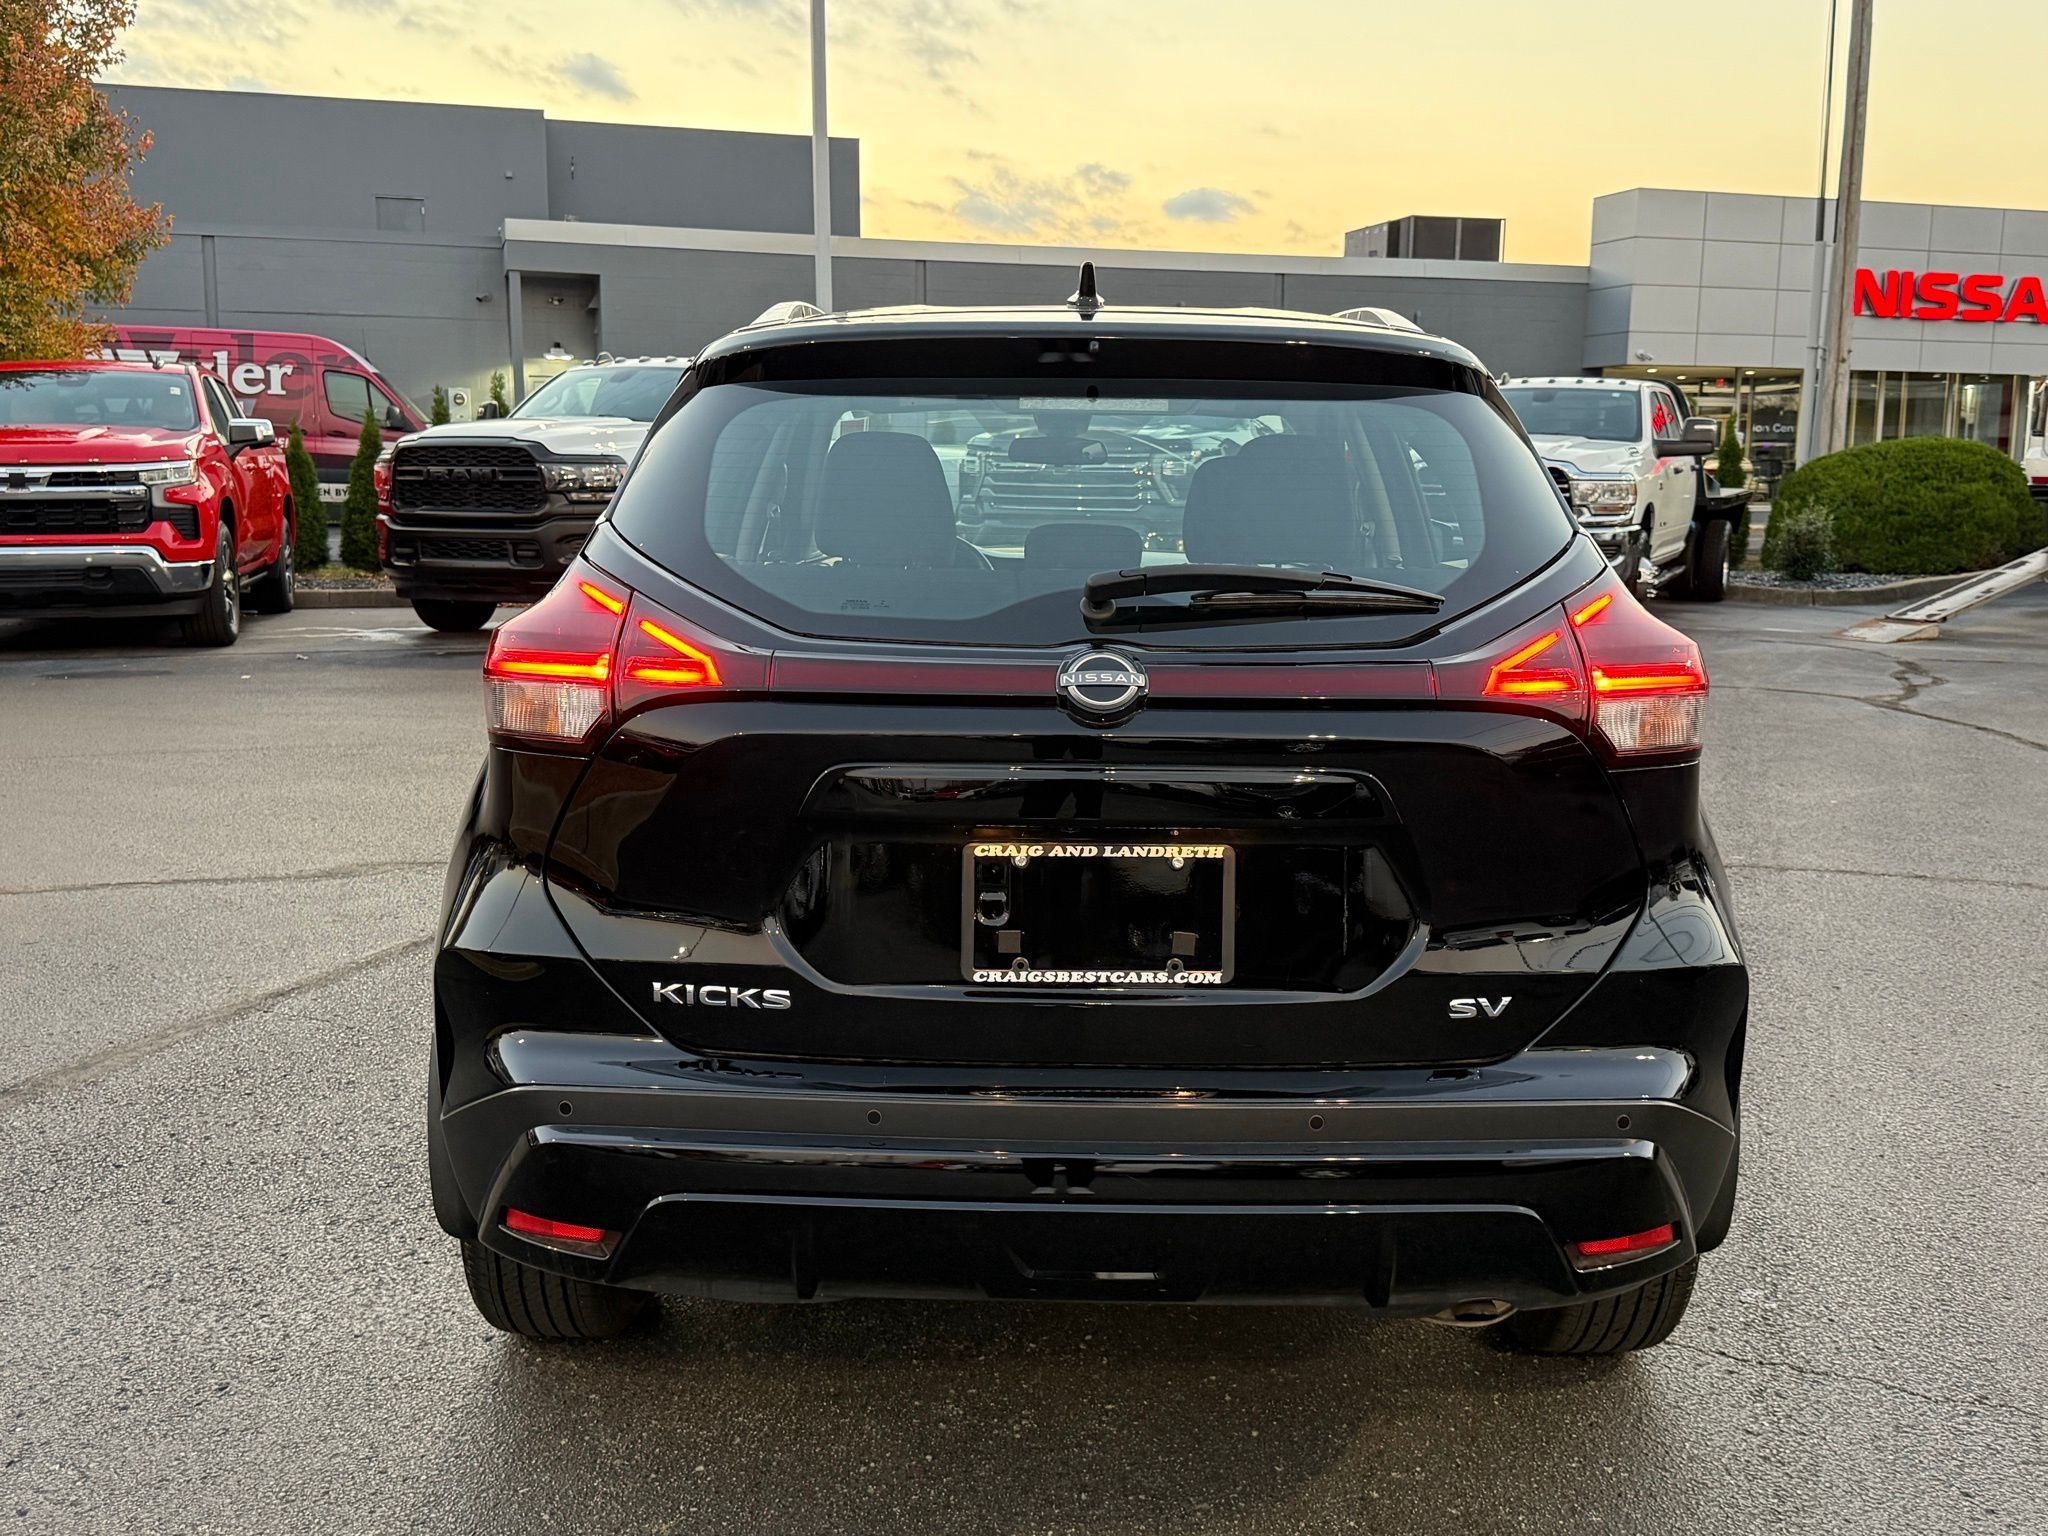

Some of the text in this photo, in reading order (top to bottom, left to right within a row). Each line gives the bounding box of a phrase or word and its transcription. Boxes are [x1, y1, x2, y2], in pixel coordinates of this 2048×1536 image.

[1853, 268, 2048, 325] NISSA
[1062, 673, 1143, 684] NISSAN
[973, 844, 1225, 858] CRAIG AND LANDRETH
[972, 971, 1223, 984] CRAIGSBESTCARS.COM
[652, 981, 792, 1010] KICKS
[1448, 996, 1513, 1019] SV
